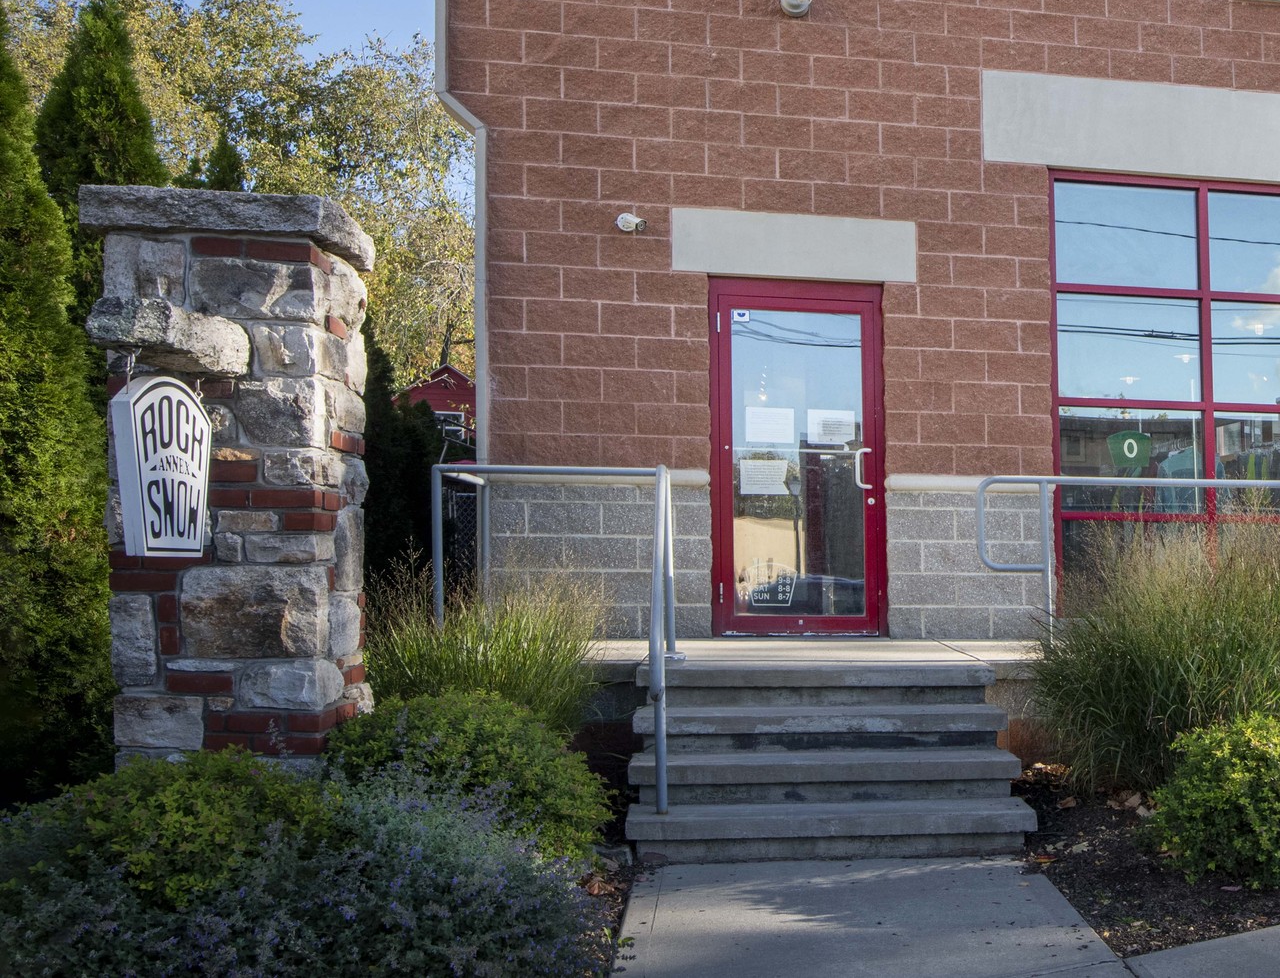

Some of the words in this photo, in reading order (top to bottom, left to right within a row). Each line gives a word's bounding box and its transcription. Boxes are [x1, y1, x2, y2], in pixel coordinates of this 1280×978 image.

[140, 395, 204, 471] ROCK
[158, 454, 191, 476] ANNEX
[147, 477, 201, 540] SNOW
[753, 592, 770, 600] SUN
[777, 592, 790, 600] 8-7
[754, 584, 769, 592] SAT
[777, 584, 791, 592] 8-8
